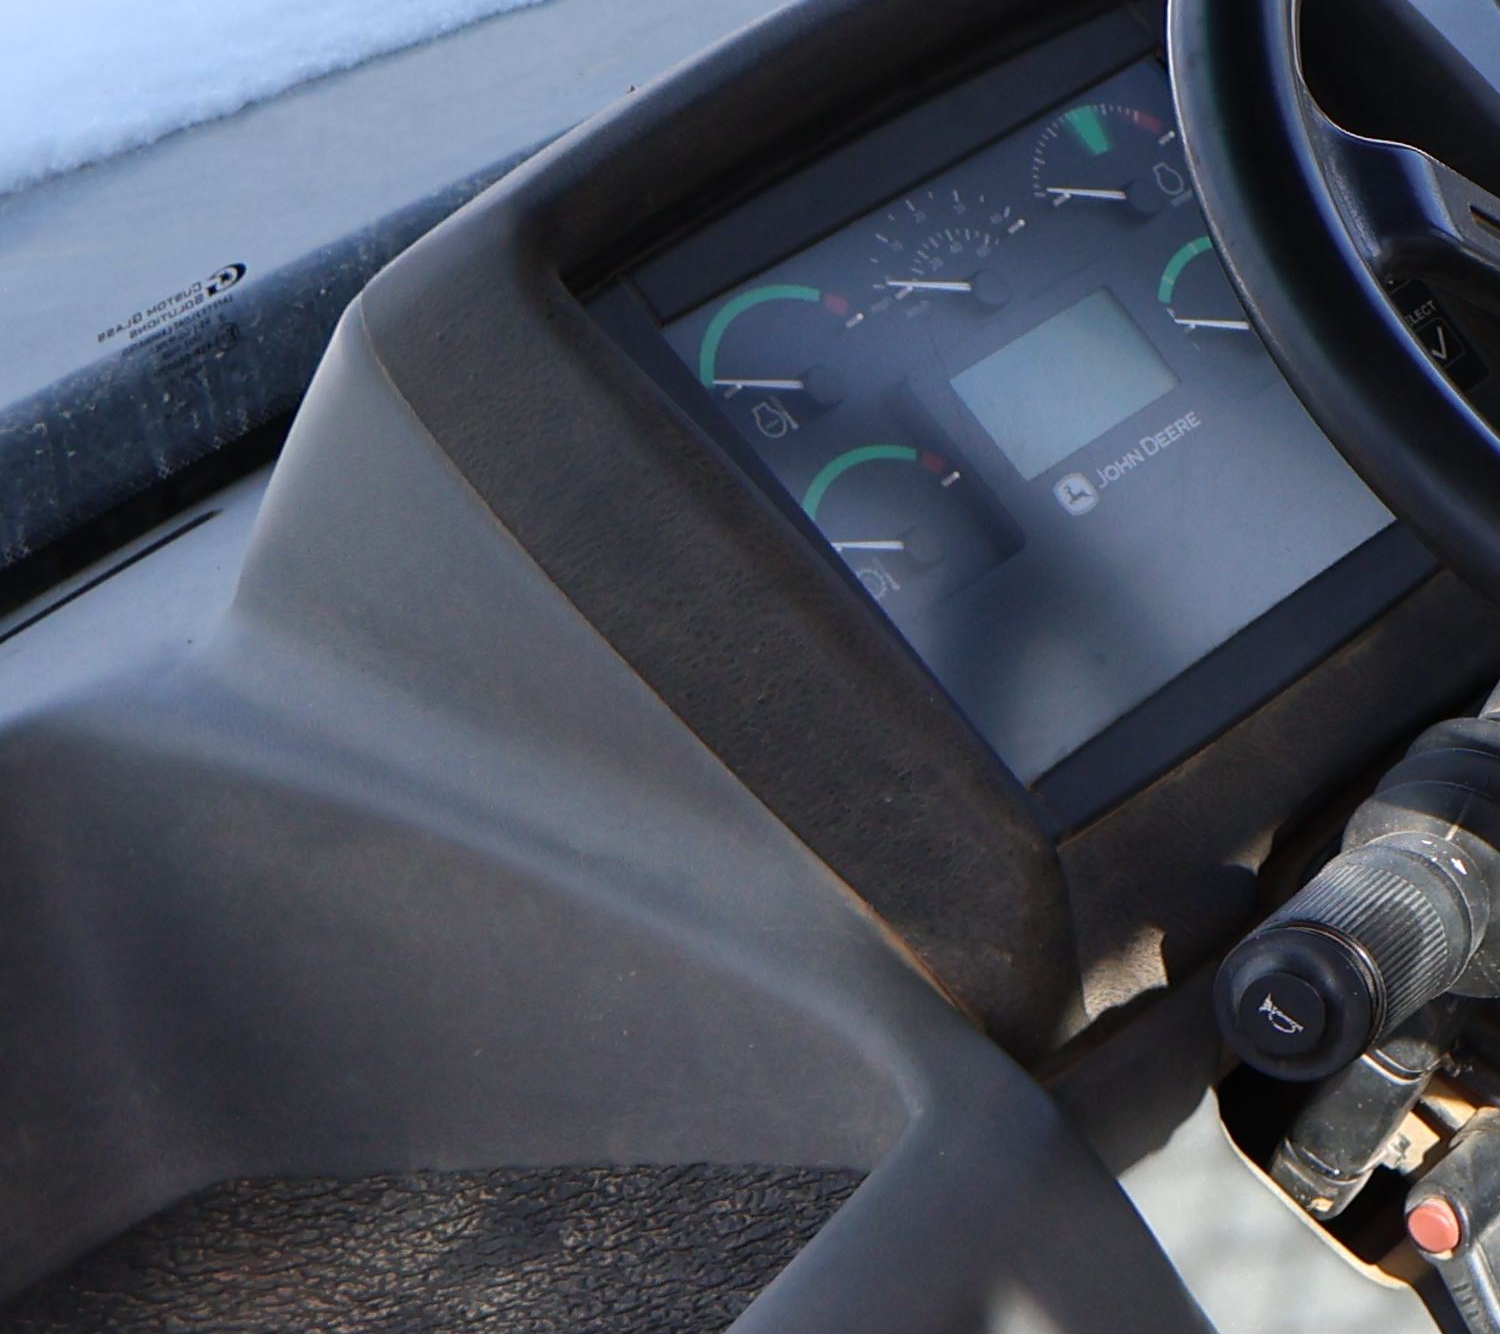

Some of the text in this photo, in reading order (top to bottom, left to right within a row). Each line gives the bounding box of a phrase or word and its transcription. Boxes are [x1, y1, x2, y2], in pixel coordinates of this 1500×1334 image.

[1404, 300, 1436, 326] ELECT
[1096, 410, 1201, 488] JOHN DEERE
